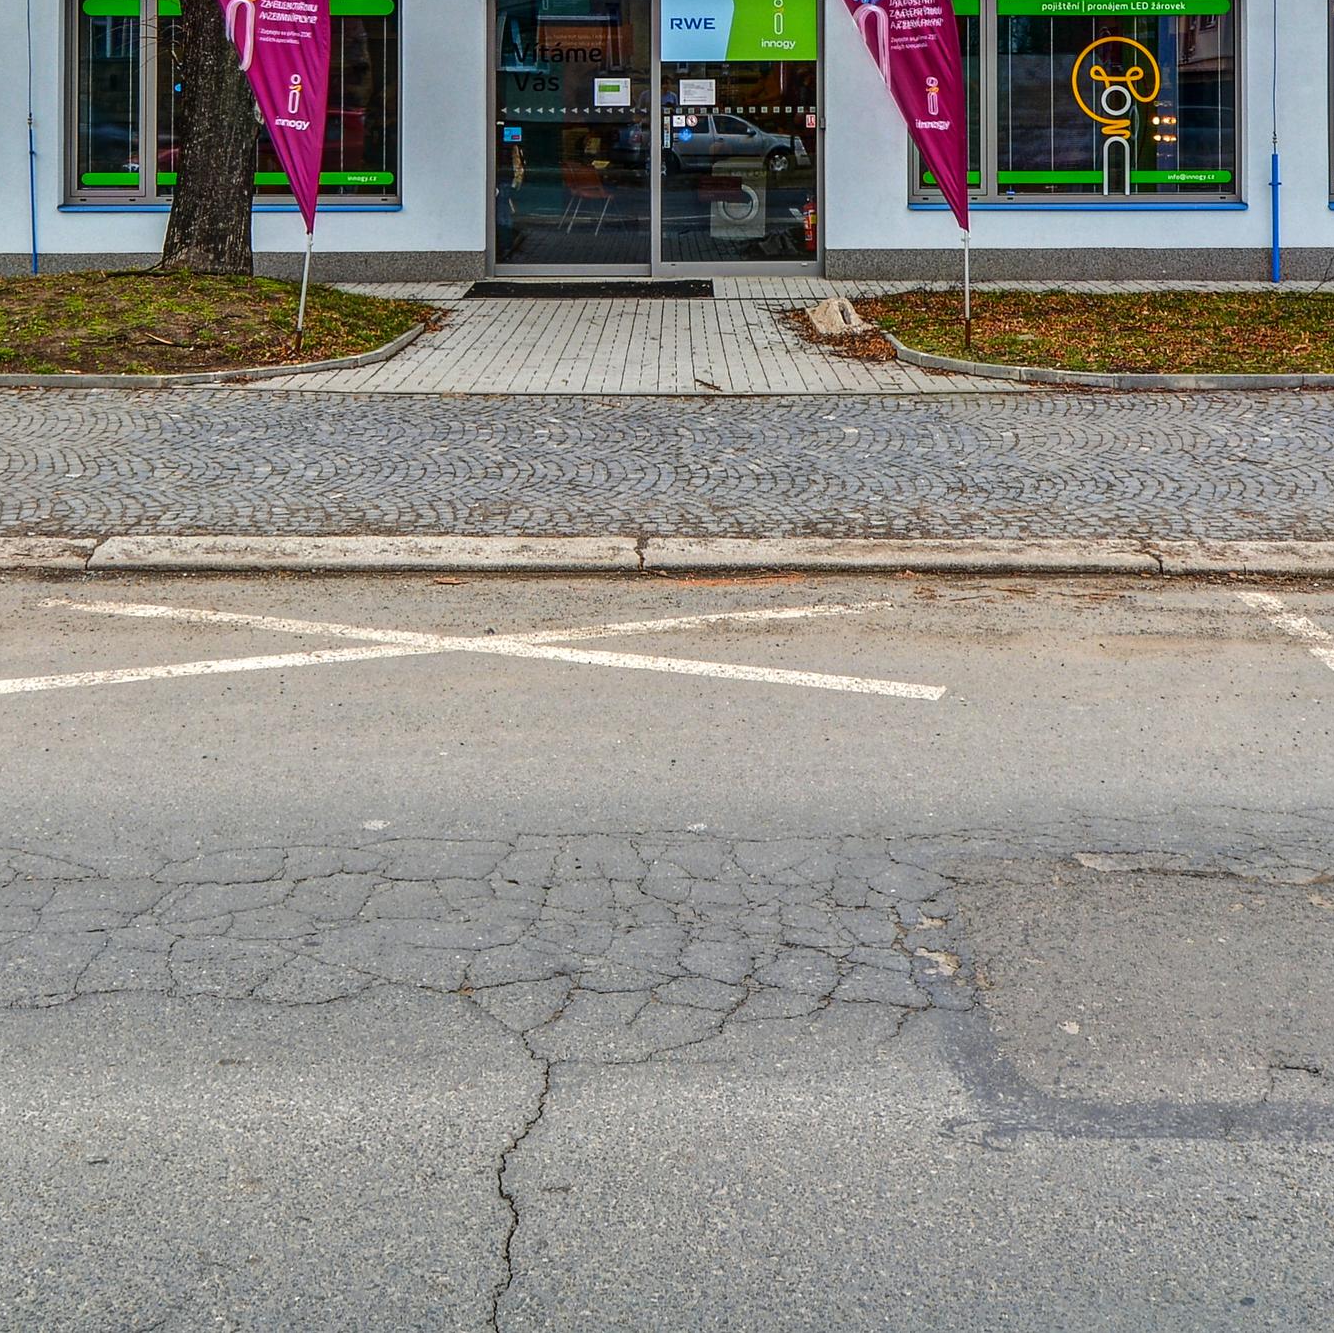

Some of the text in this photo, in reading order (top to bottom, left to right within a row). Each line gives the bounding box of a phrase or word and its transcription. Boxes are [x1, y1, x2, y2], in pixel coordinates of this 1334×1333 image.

[1041, 1, 1080, 12] pojištění
[1087, 1, 1128, 12] pronájem
[1130, 1, 1149, 10] LED
[1150, 1, 1186, 10] žárovek
[670, 17, 716, 30] RWE
[761, 38, 796, 50] innogy
[513, 42, 602, 63] Vítáme
[513, 71, 560, 92] Vás
